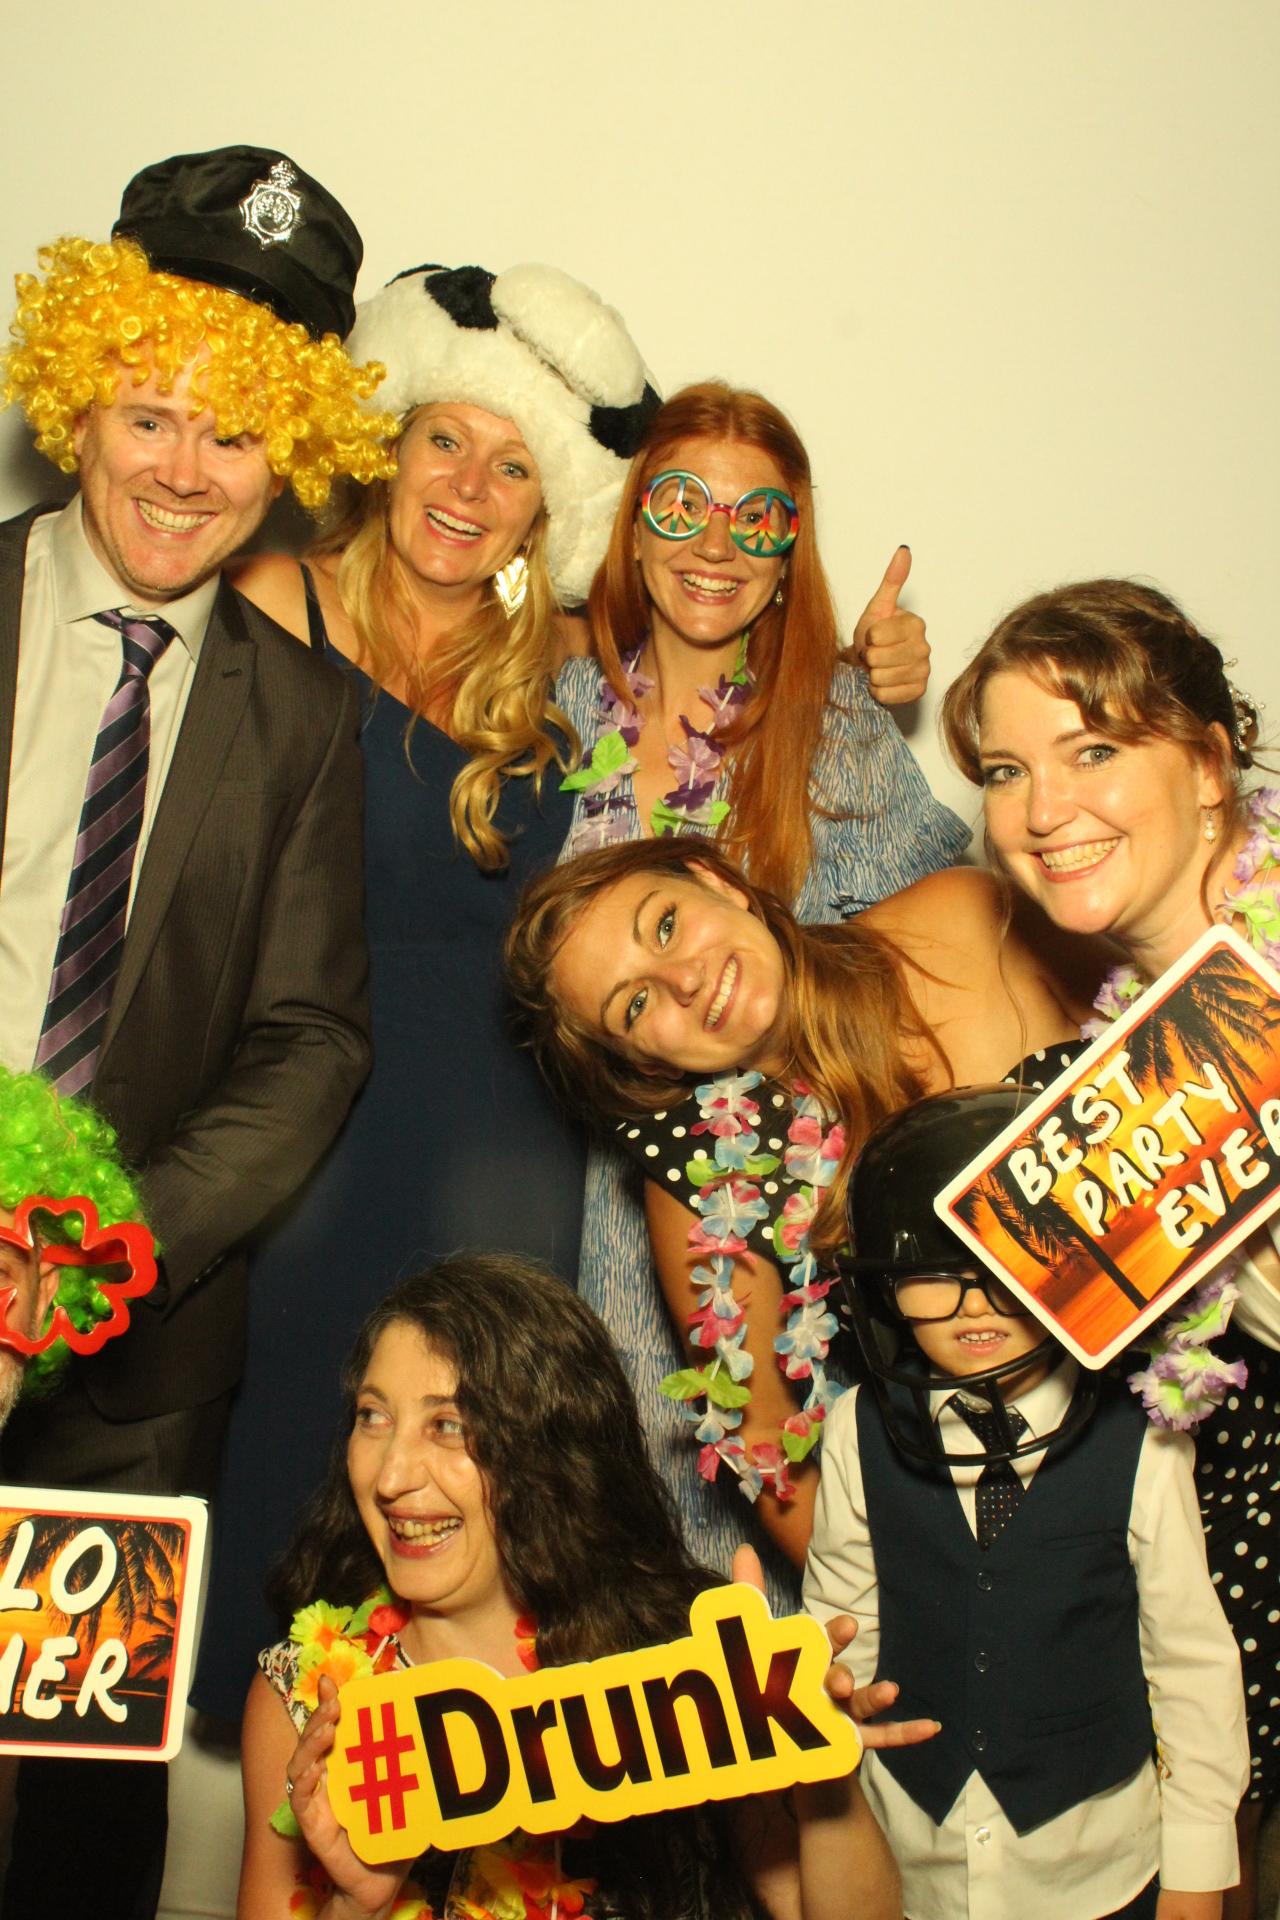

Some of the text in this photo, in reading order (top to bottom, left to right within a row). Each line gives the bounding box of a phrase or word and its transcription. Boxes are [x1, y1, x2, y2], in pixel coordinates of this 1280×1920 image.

[1008, 1052, 1143, 1205] BEST
[1073, 1062, 1239, 1235] PARTY
[345, 1615, 831, 1834] #Drunk
